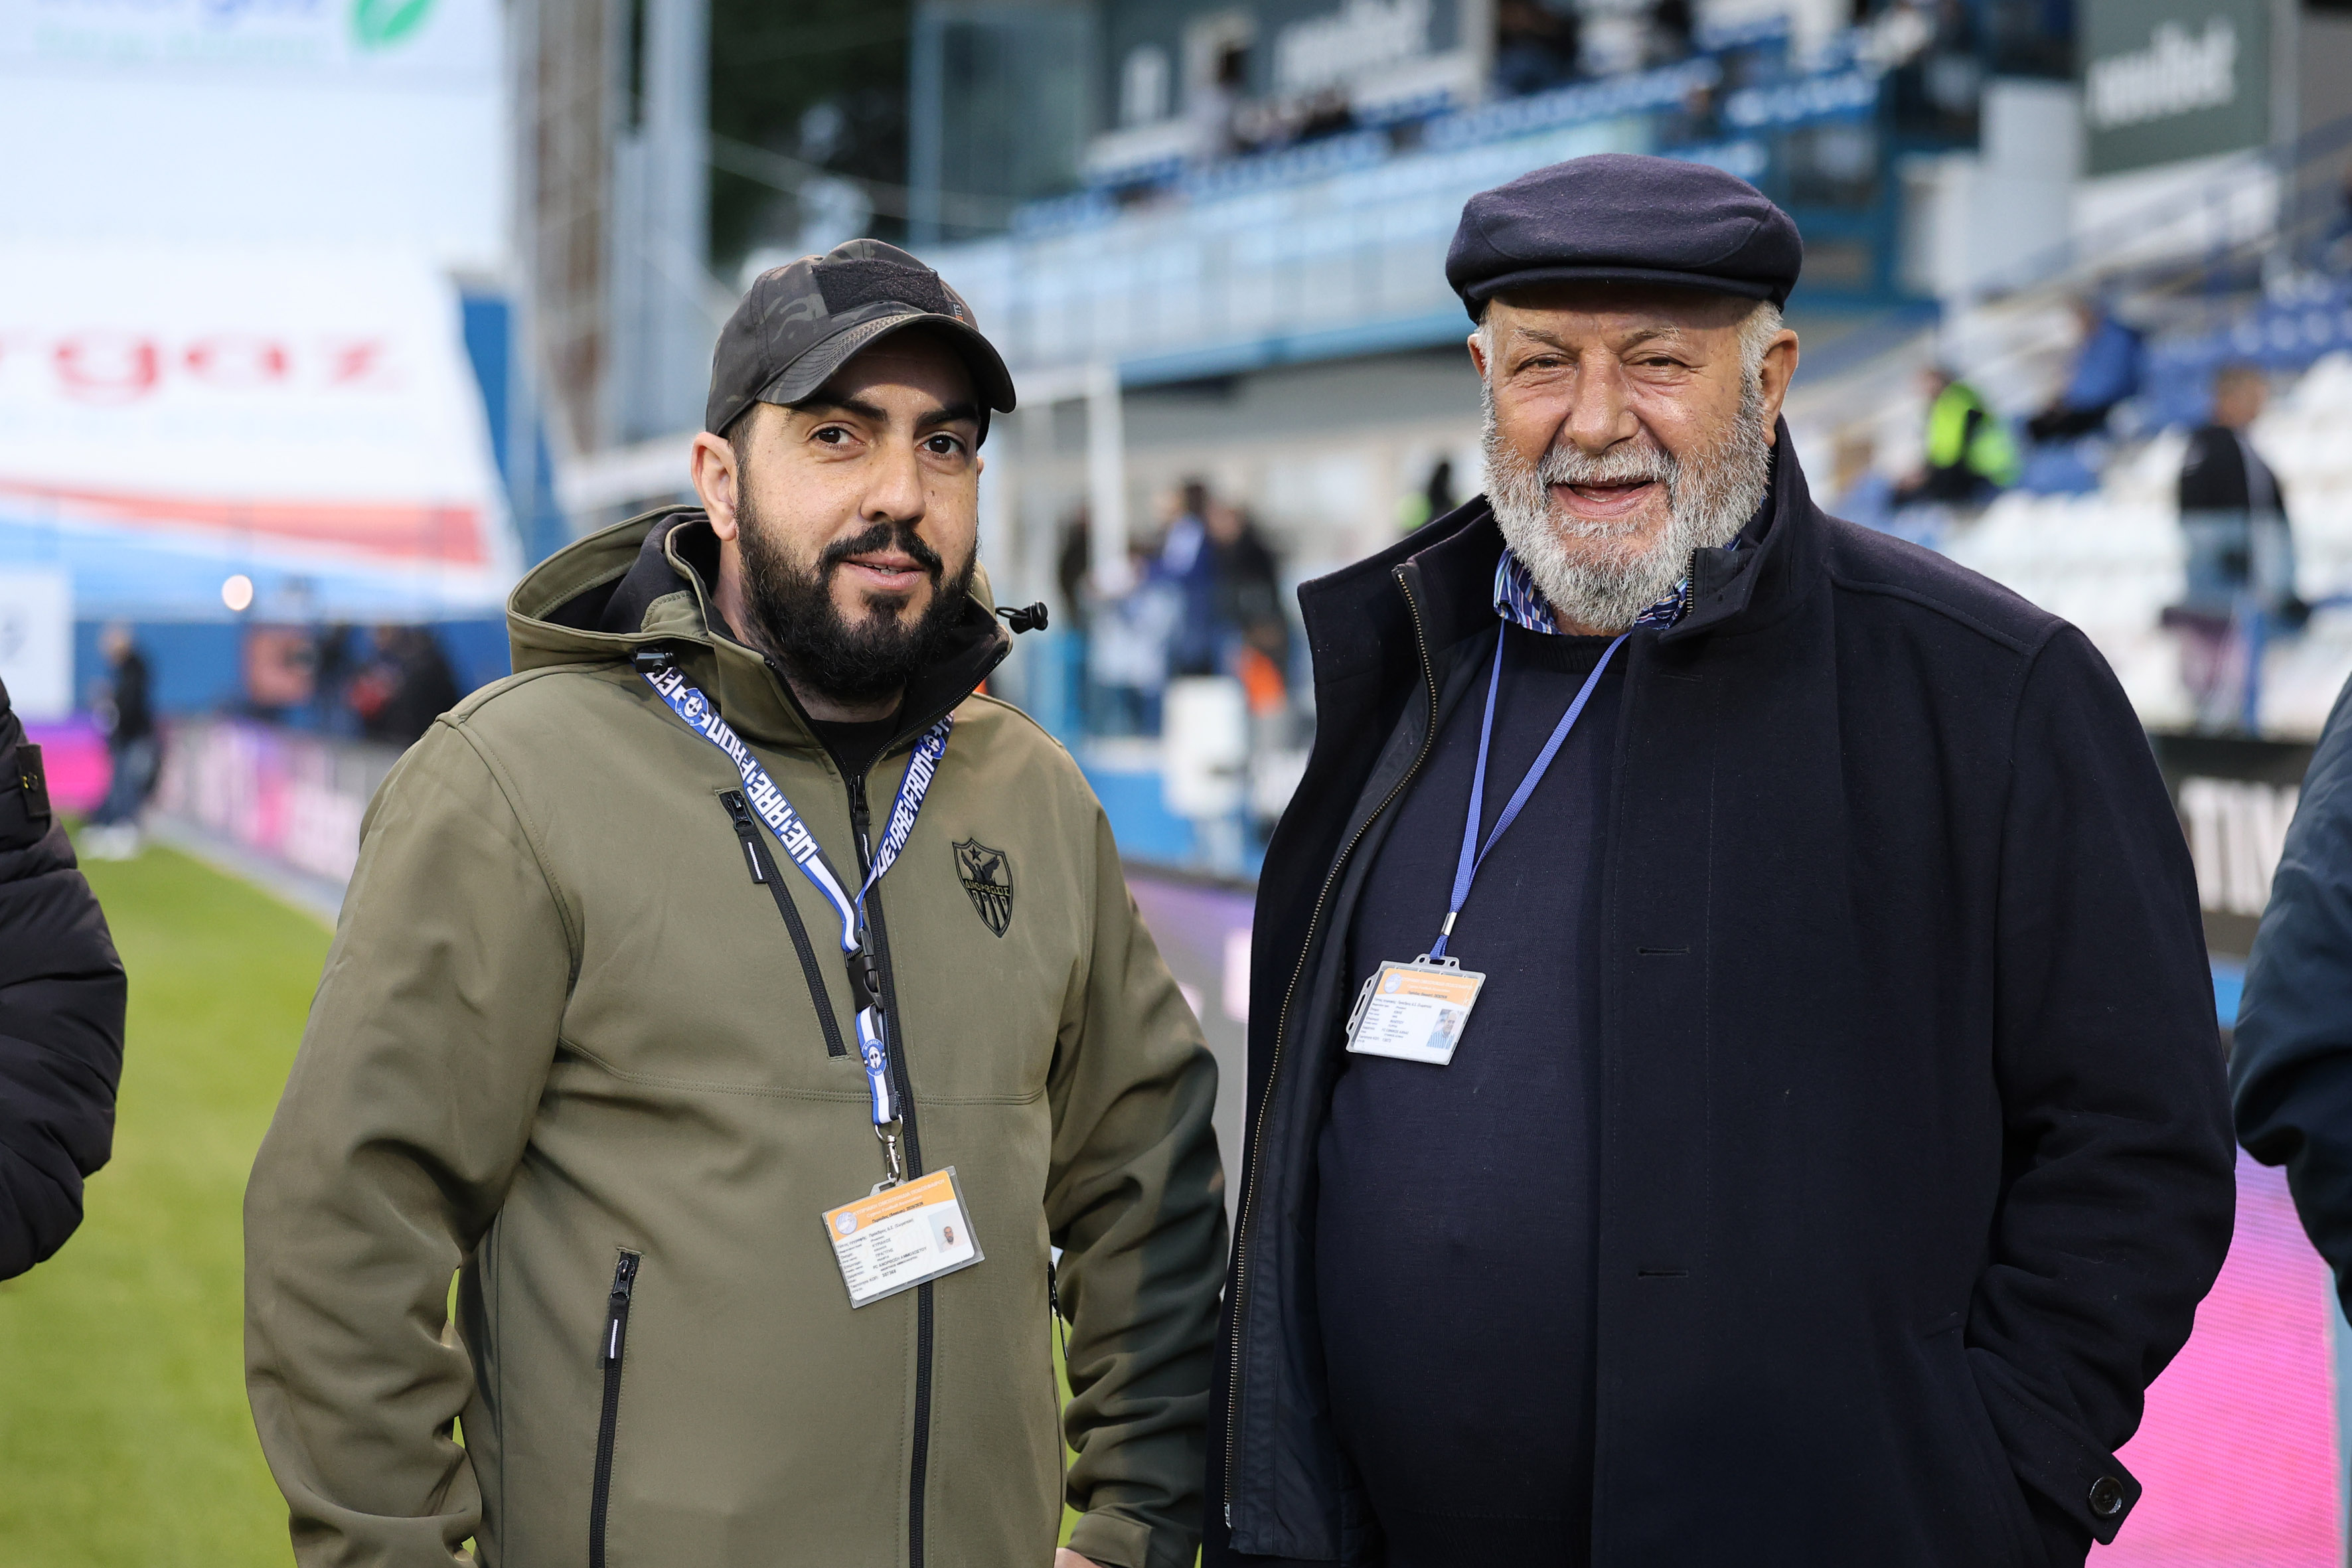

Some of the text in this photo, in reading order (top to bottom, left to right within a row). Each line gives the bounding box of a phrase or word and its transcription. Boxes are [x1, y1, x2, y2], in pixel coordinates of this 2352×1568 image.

[705, 715, 819, 864] WE ARE FROM
[876, 751, 935, 879] WE ARE FROM
